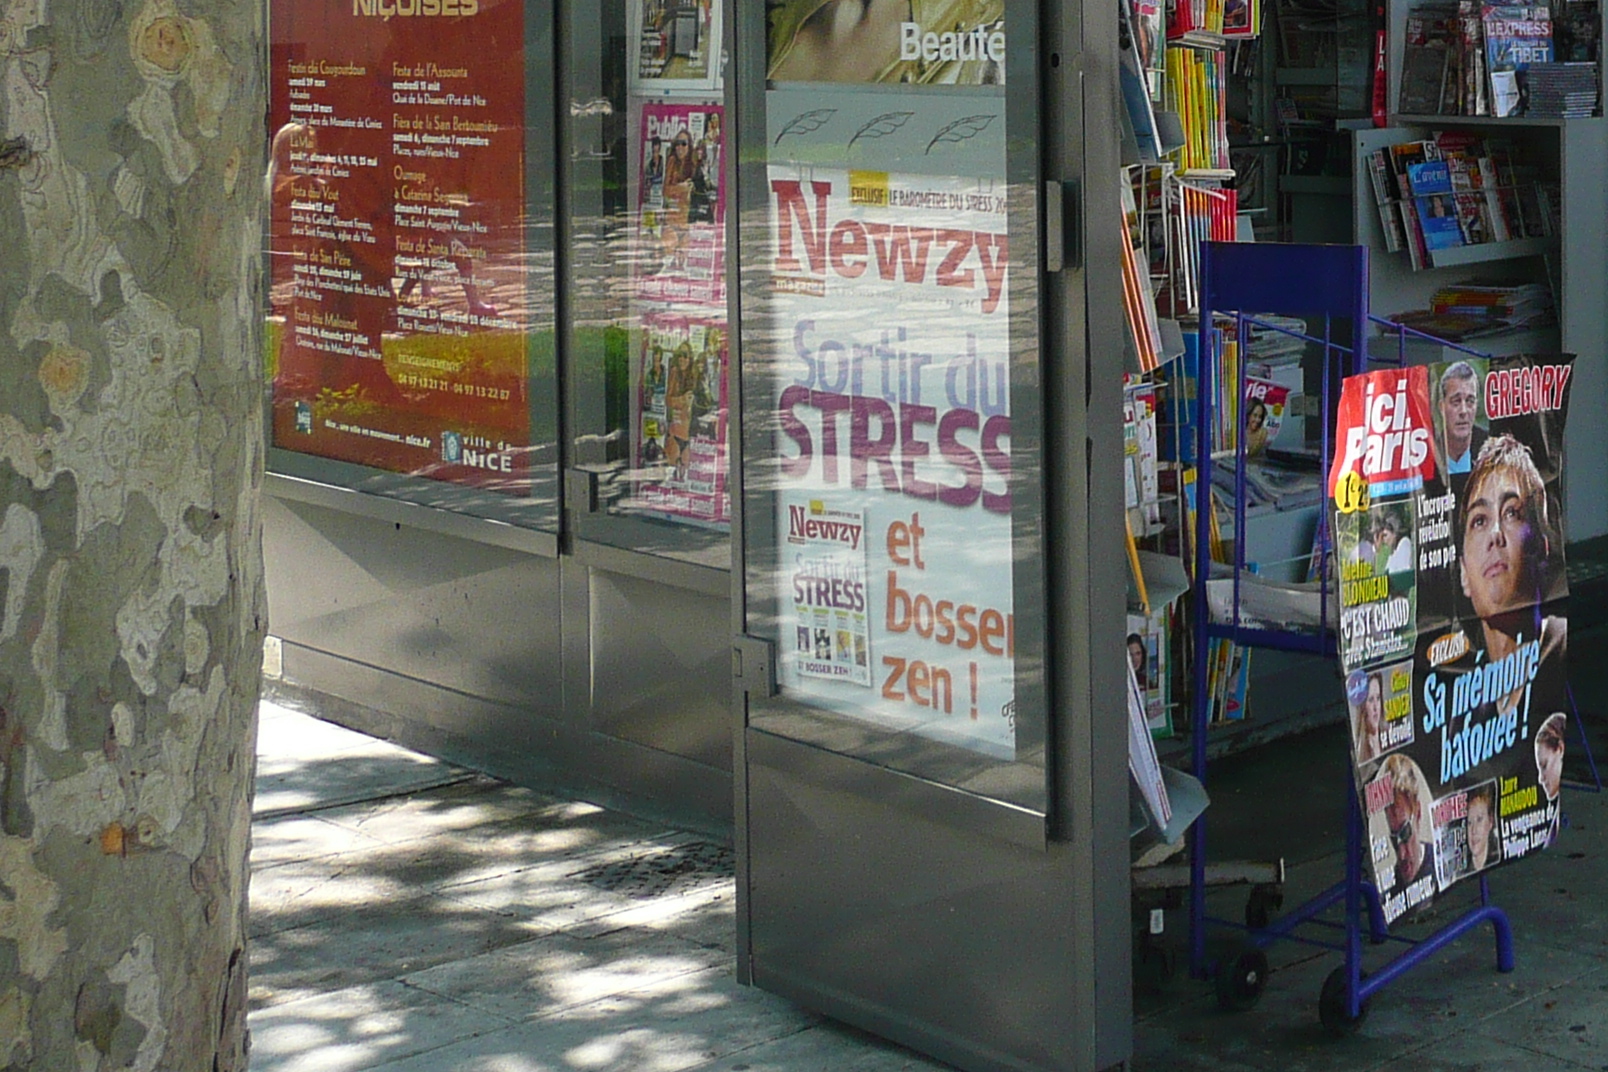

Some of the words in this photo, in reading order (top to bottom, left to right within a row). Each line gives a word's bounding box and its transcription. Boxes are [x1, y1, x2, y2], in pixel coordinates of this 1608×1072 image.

[900, 20, 1005, 64] Beauté
[1486, 20, 1550, 37] L'EXPRESS
[1510, 47, 1550, 63] TIBET
[771, 179, 1009, 314] Newzy
[793, 319, 932, 406] Sortir
[946, 333, 1008, 418] du
[1485, 365, 1571, 420] GREGORY
[1364, 378, 1408, 434] ici
[463, 435, 491, 448] ville
[778, 384, 1012, 516] STRESS
[1338, 416, 1429, 479] Paris
[789, 504, 862, 550] Newzy
[886, 512, 926, 571] et
[793, 573, 865, 613] STRESS
[882, 655, 953, 715] zen
[1423, 672, 1448, 734] Sa
[1451, 632, 1541, 718] mémoire
[1440, 691, 1518, 786] bafouée
